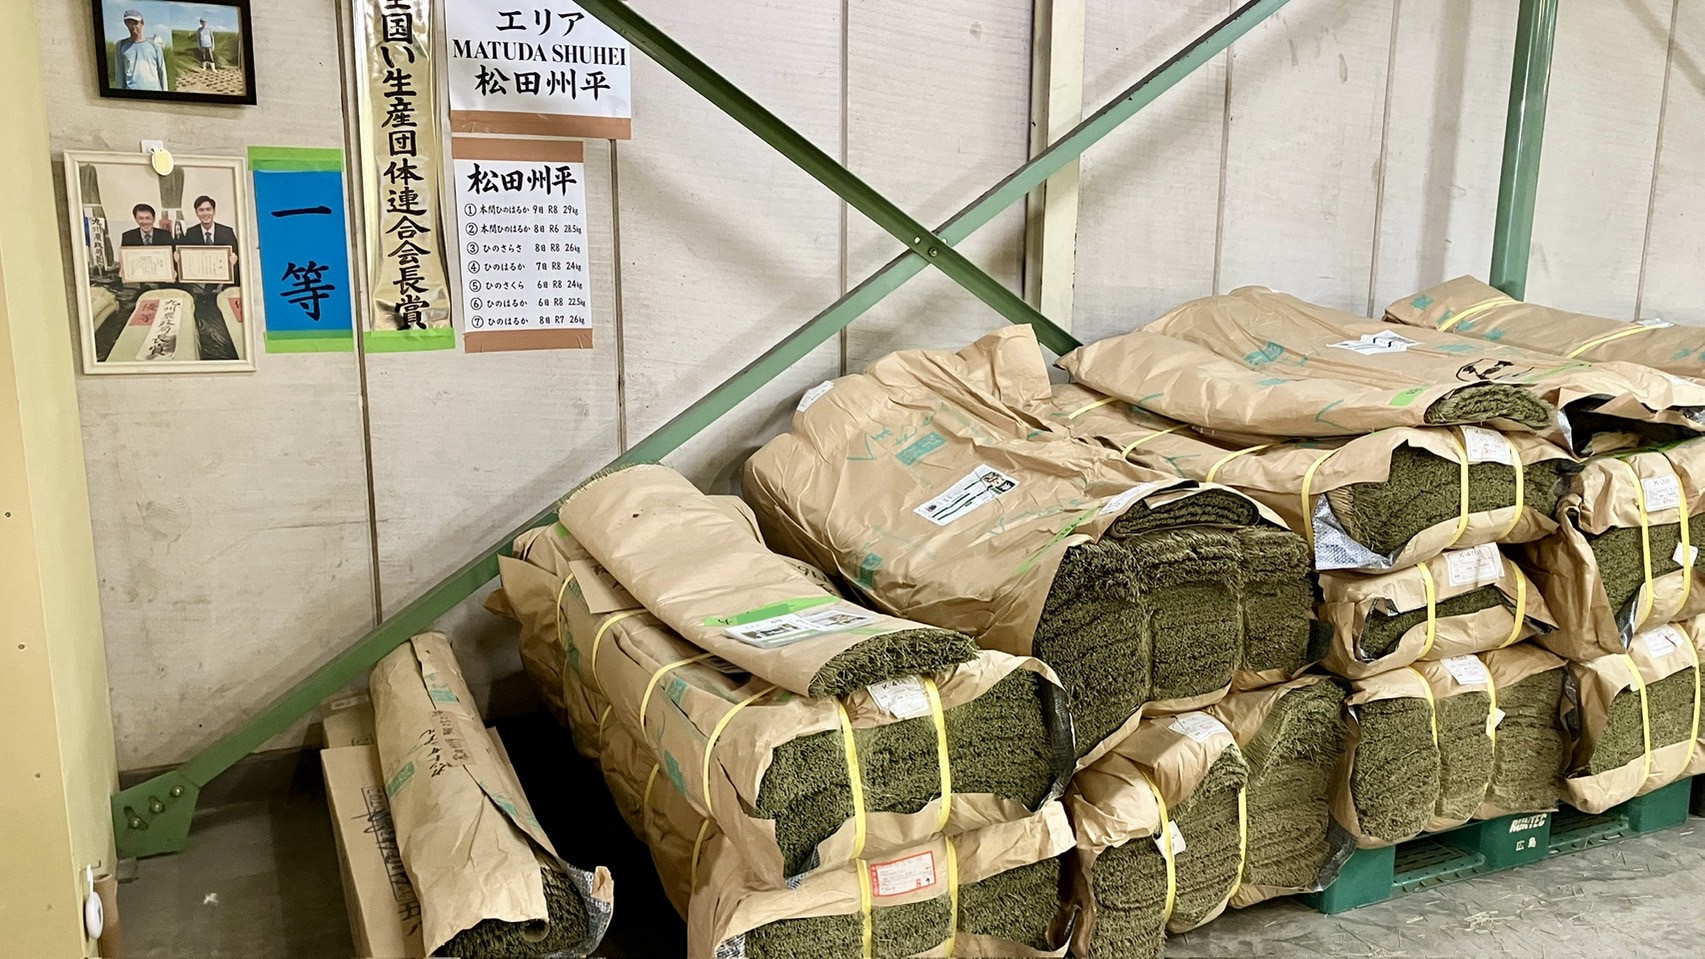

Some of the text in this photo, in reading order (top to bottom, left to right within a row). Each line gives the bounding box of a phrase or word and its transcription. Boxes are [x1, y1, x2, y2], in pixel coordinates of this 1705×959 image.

[496, 8, 585, 36] エリア
[452, 39, 627, 66] MATUDA SHUHEI
[474, 64, 611, 101] 松田州平
[466, 163, 577, 197] 松田州平
[548, 204, 558, 214] R8
[549, 224, 559, 233] R6
[483, 244, 522, 253] ひのさらさ
[550, 243, 560, 252] R8
[270, 205, 336, 321] 一等
[484, 262, 526, 272] ひのはるか
[551, 261, 561, 271] R8
[486, 281, 525, 291] ひのさくら
[552, 280, 562, 289] R8
[487, 299, 528, 309] ひのはるか
[553, 297, 563, 307] R8
[488, 317, 529, 327] ひのはるか
[554, 315, 565, 324] R7
